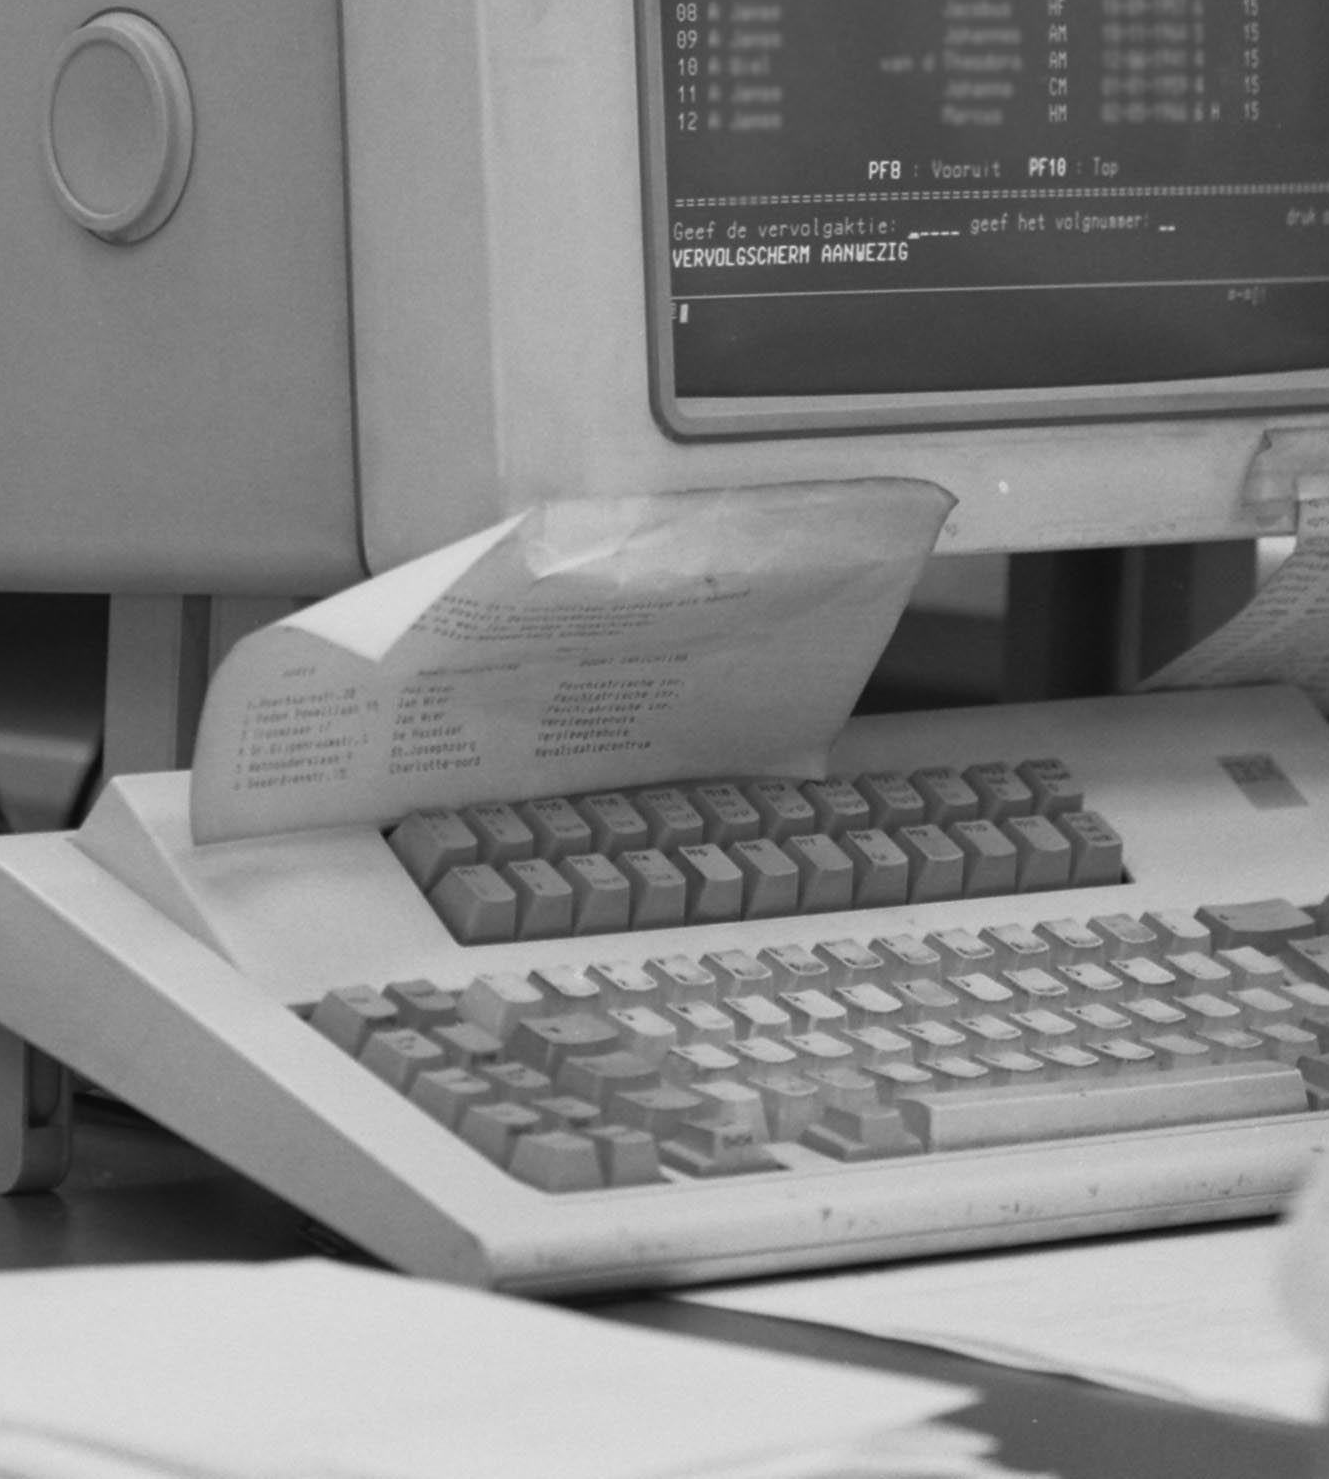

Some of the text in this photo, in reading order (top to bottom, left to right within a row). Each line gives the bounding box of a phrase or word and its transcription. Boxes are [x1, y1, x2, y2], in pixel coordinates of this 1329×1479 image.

[869, 160, 901, 179] PF8
[931, 160, 1001, 178] Vooruit
[1029, 157, 1066, 176] PF10
[1093, 157, 1119, 178] Top
[673, 221, 716, 242] Geef
[727, 220, 747, 239] de
[970, 212, 1008, 234] geef
[1018, 213, 1045, 231] het
[673, 242, 908, 268] VERVOLGSCHERM AANWEZIG
